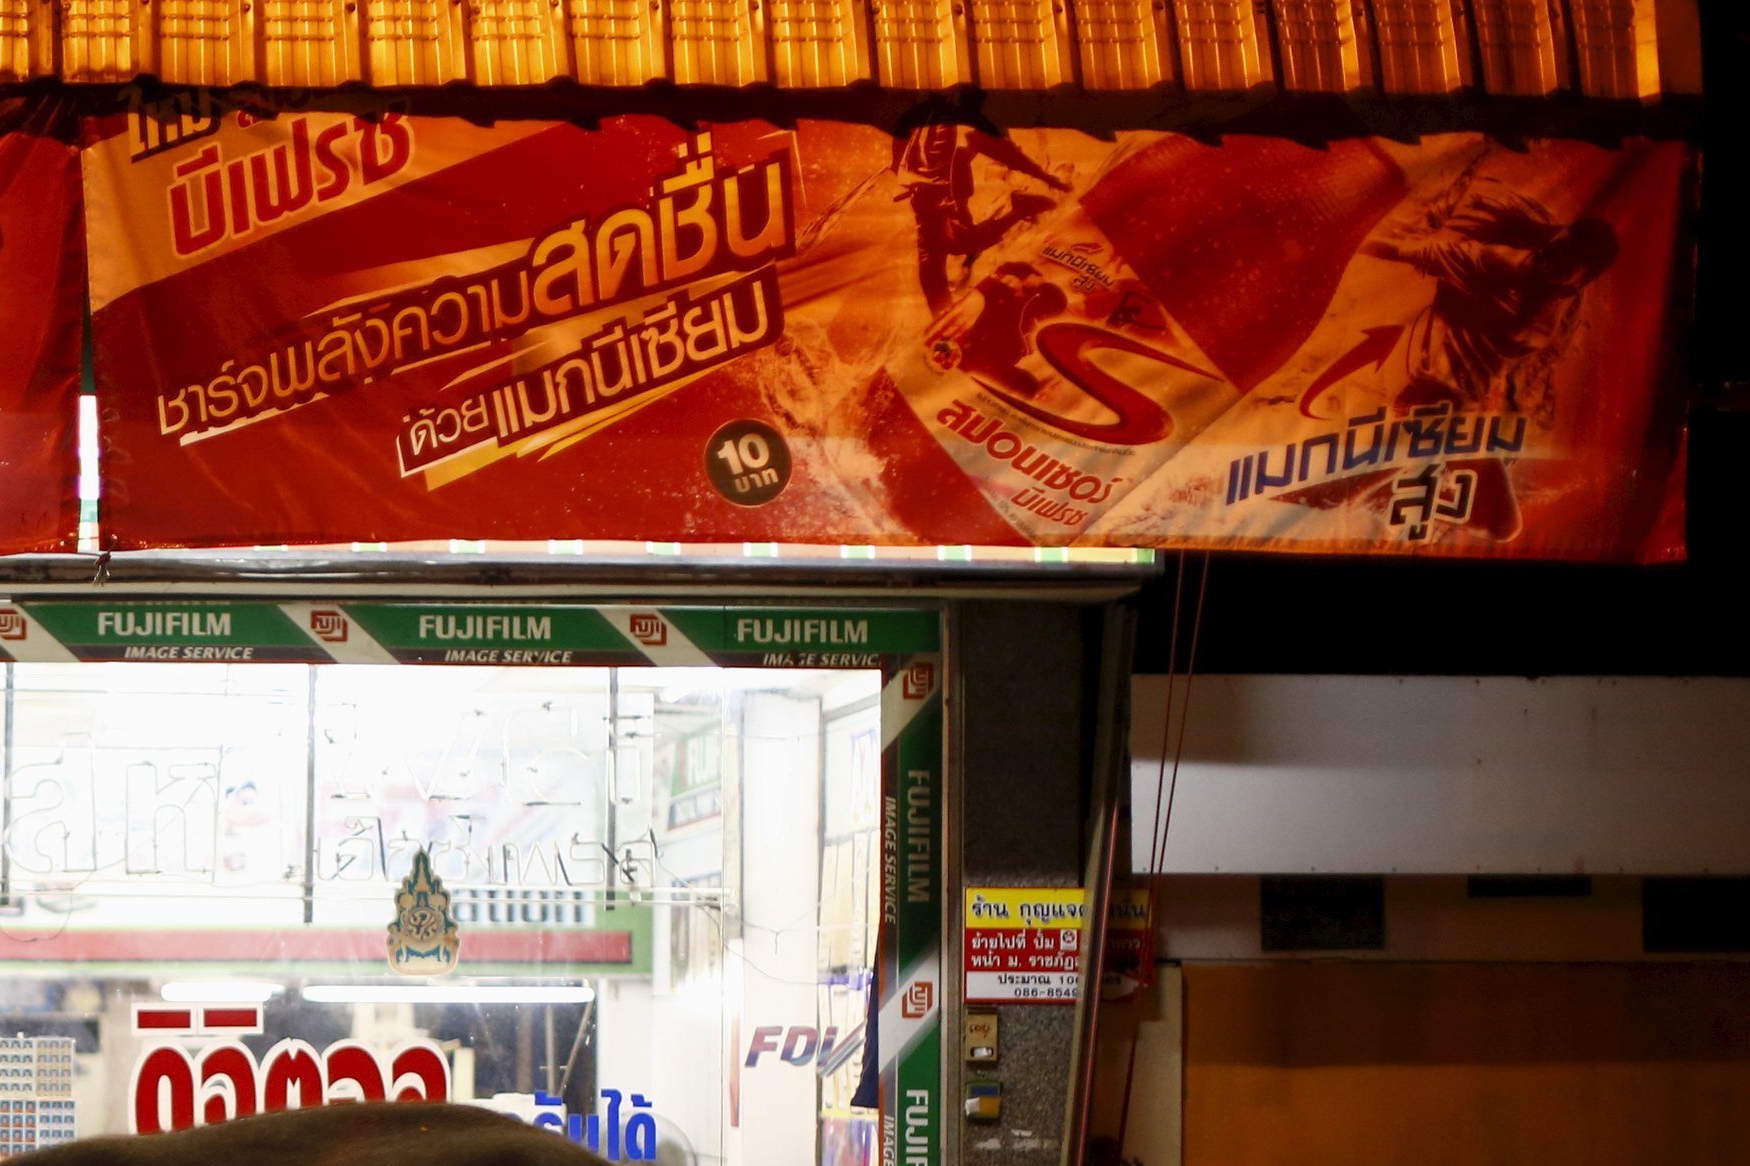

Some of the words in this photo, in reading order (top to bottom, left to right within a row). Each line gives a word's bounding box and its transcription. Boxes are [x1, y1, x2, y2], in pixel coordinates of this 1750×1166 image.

[168, 103, 412, 257] บีเฟรช
[717, 432, 770, 476] 10
[1225, 402, 1527, 506] แมกนีเซียม
[734, 466, 779, 494] บาท
[1389, 463, 1472, 542] สูง
[97, 611, 232, 637] FUJIFILM
[419, 614, 552, 641] FUJIFILM
[736, 618, 869, 645] FUJIFILM
[124, 645, 179, 660] IMAGE
[182, 645, 254, 660] SERVICE
[444, 648, 499, 664] IMAGE
[502, 648, 572, 664] SERVICE
[819, 652, 882, 667] SERVIC
[884, 796, 896, 851] IMAGE
[907, 770, 931, 904] FUJIFILM
[884, 854, 896, 925] SERVICE
[971, 894, 1010, 919] ร้าน
[997, 974, 1052, 985] ประมาณ
[505, 1089, 657, 1162] รับได้
